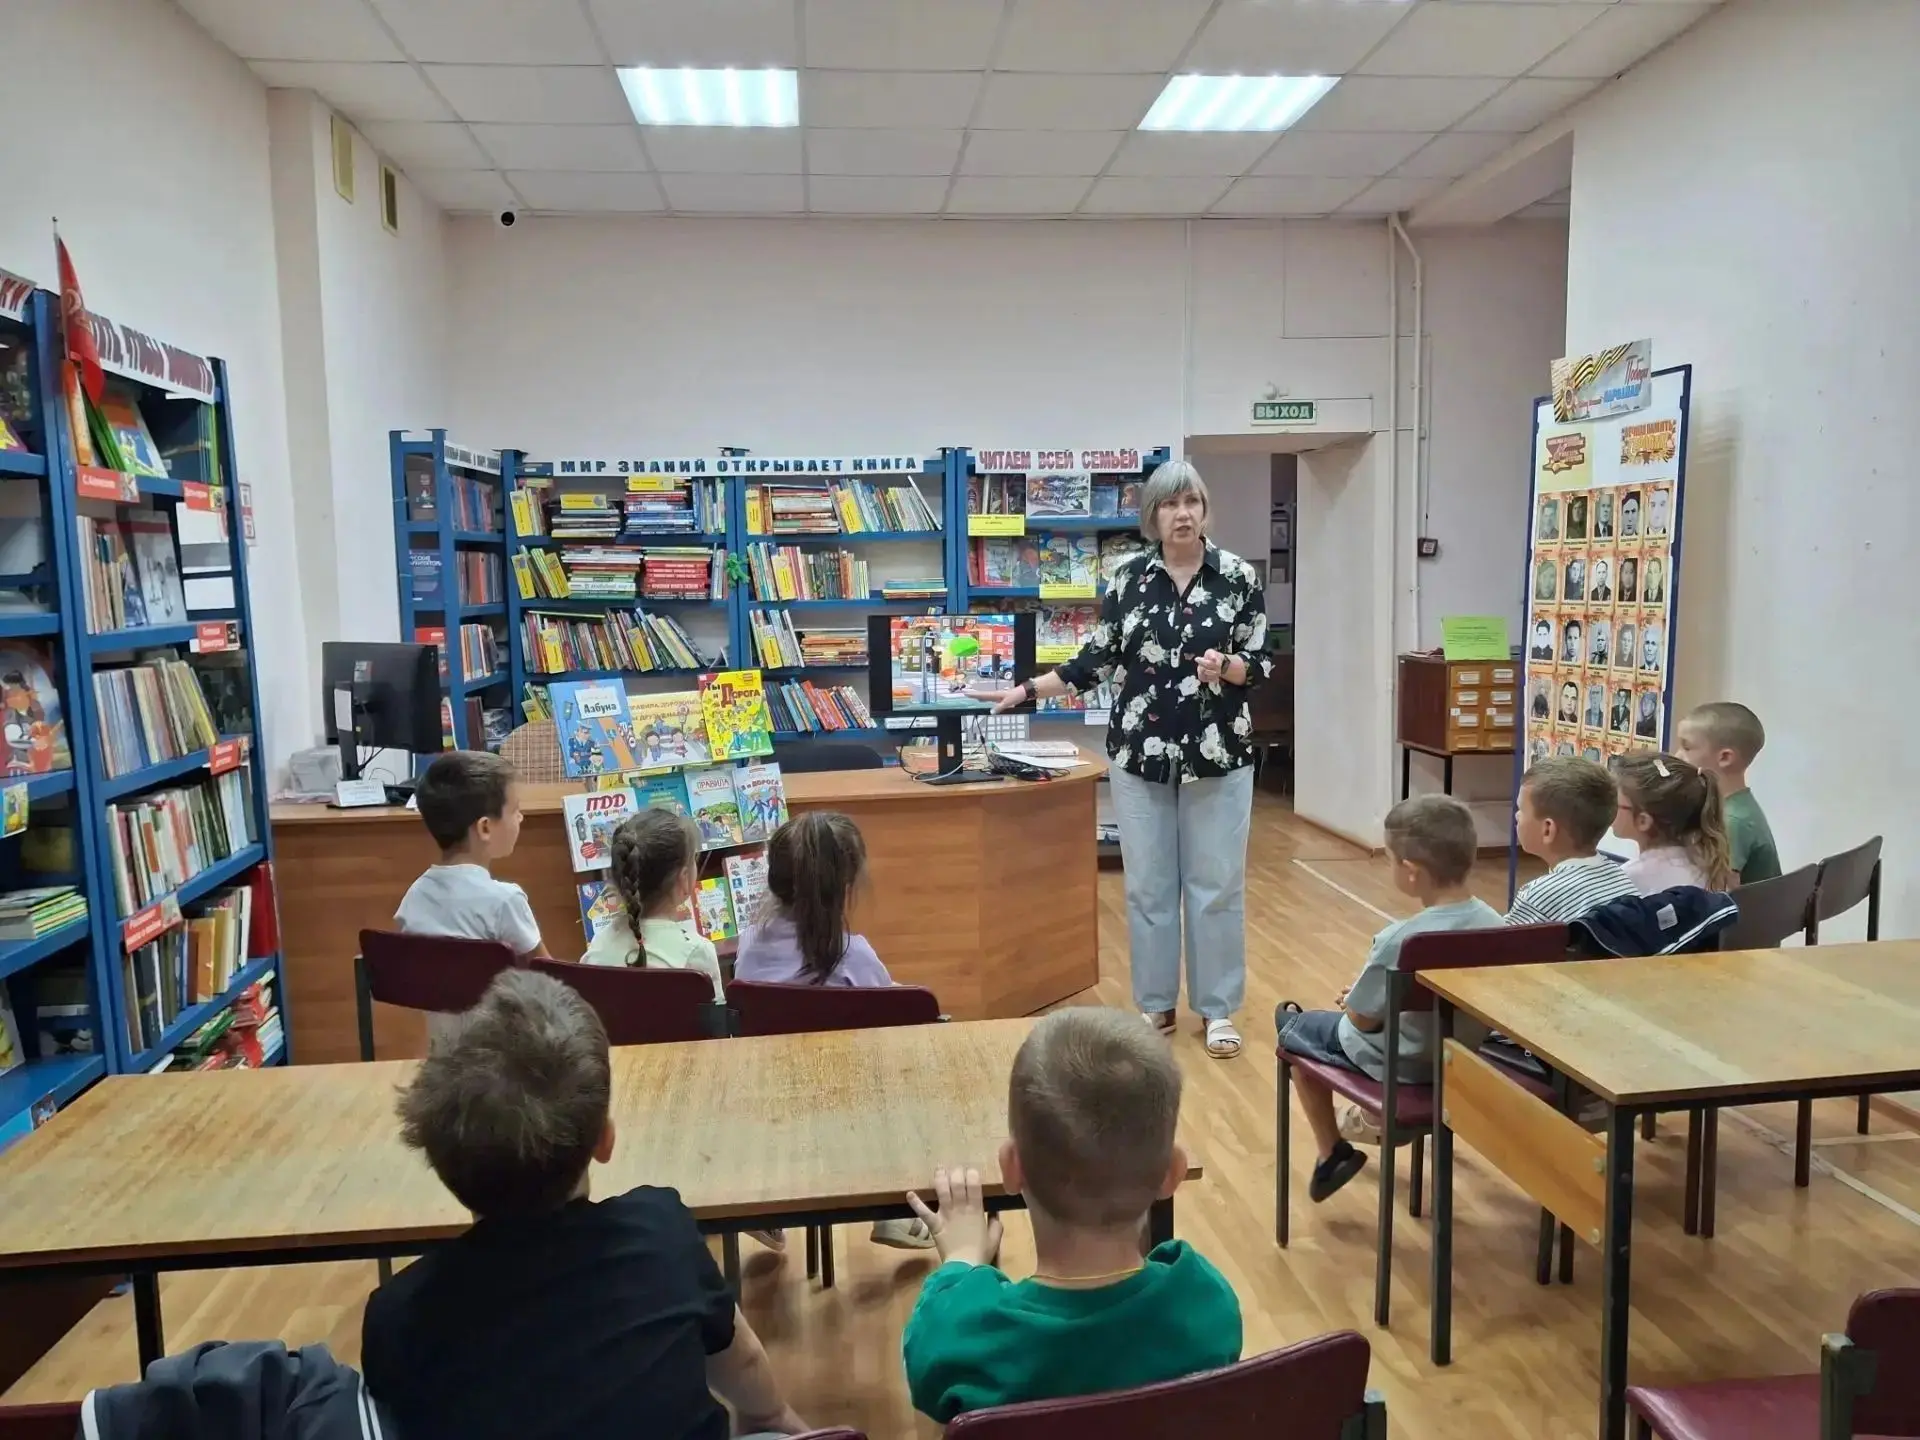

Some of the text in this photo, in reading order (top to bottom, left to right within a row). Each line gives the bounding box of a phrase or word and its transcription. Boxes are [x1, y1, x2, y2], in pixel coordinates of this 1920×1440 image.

[1256, 405, 1310, 418] ВЫХОД
[560, 457, 917, 473] МИР ЗНАНИЙ ОТКРЫВАЕТ КНИГА
[979, 449, 1139, 470] ЧИТАЕМ ВСЕЙ СЕМЬЁЙ
[584, 702, 617, 714] Азбука
[586, 794, 626, 811] ПДД
